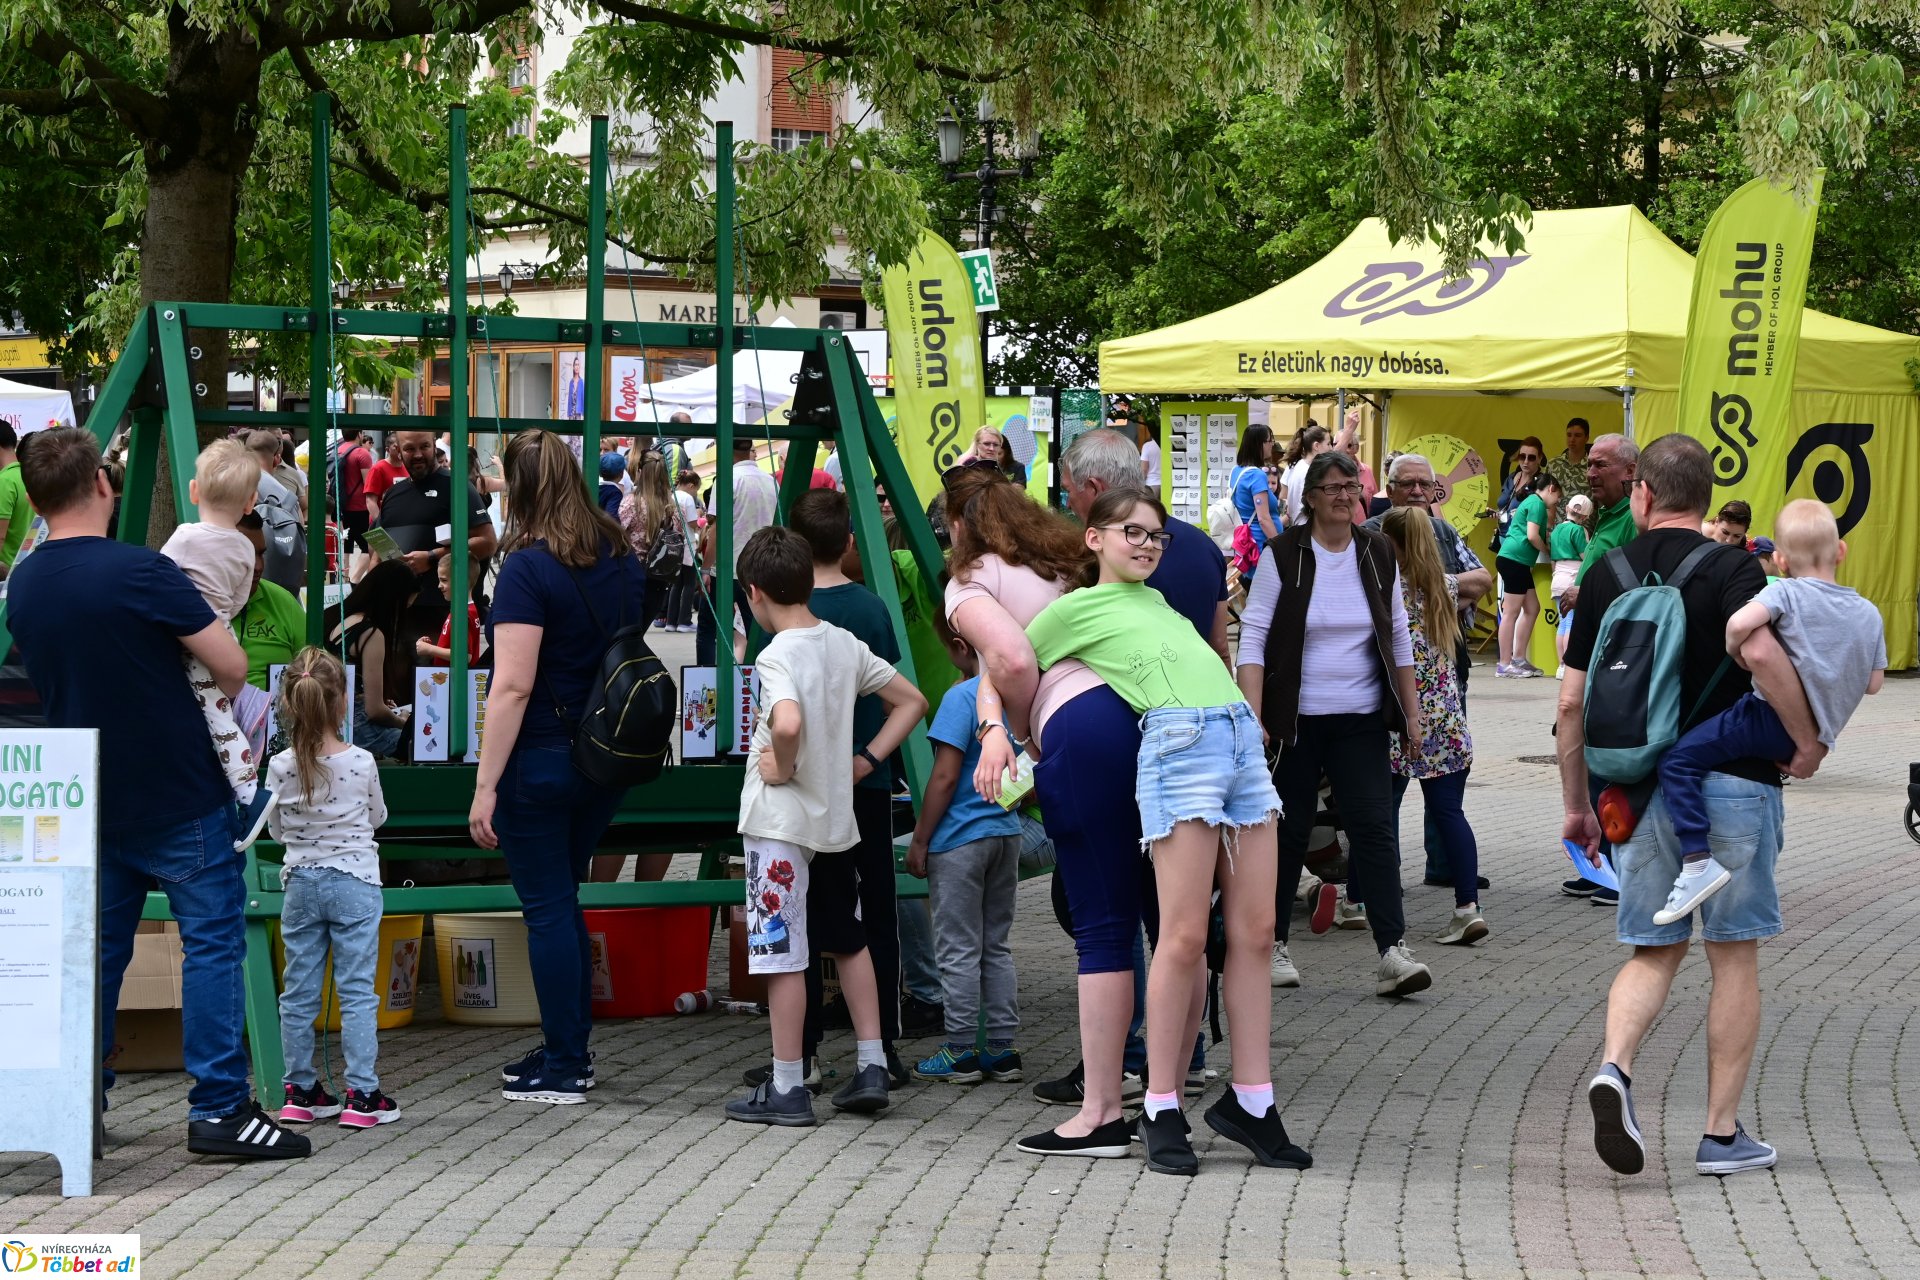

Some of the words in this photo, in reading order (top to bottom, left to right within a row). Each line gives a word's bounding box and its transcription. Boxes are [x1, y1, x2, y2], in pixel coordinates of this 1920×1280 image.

[1773, 243, 1784, 282] GROUP
[1719, 242, 1768, 376] mohu
[1771, 285, 1781, 309] MOL
[659, 303, 760, 325] MARELA
[1769, 312, 1778, 327] OF
[1238, 352, 1257, 374] Ez
[1261, 350, 1326, 374] életünk
[1331, 355, 1374, 378] nagy
[1378, 350, 1450, 375] dobása.
[1764, 330, 1777, 376] MEMBER
[615, 368, 640, 422] Cooper
[458, 998, 490, 1007] HULLADÉK
[464, 991, 481, 999] ÜVEG
